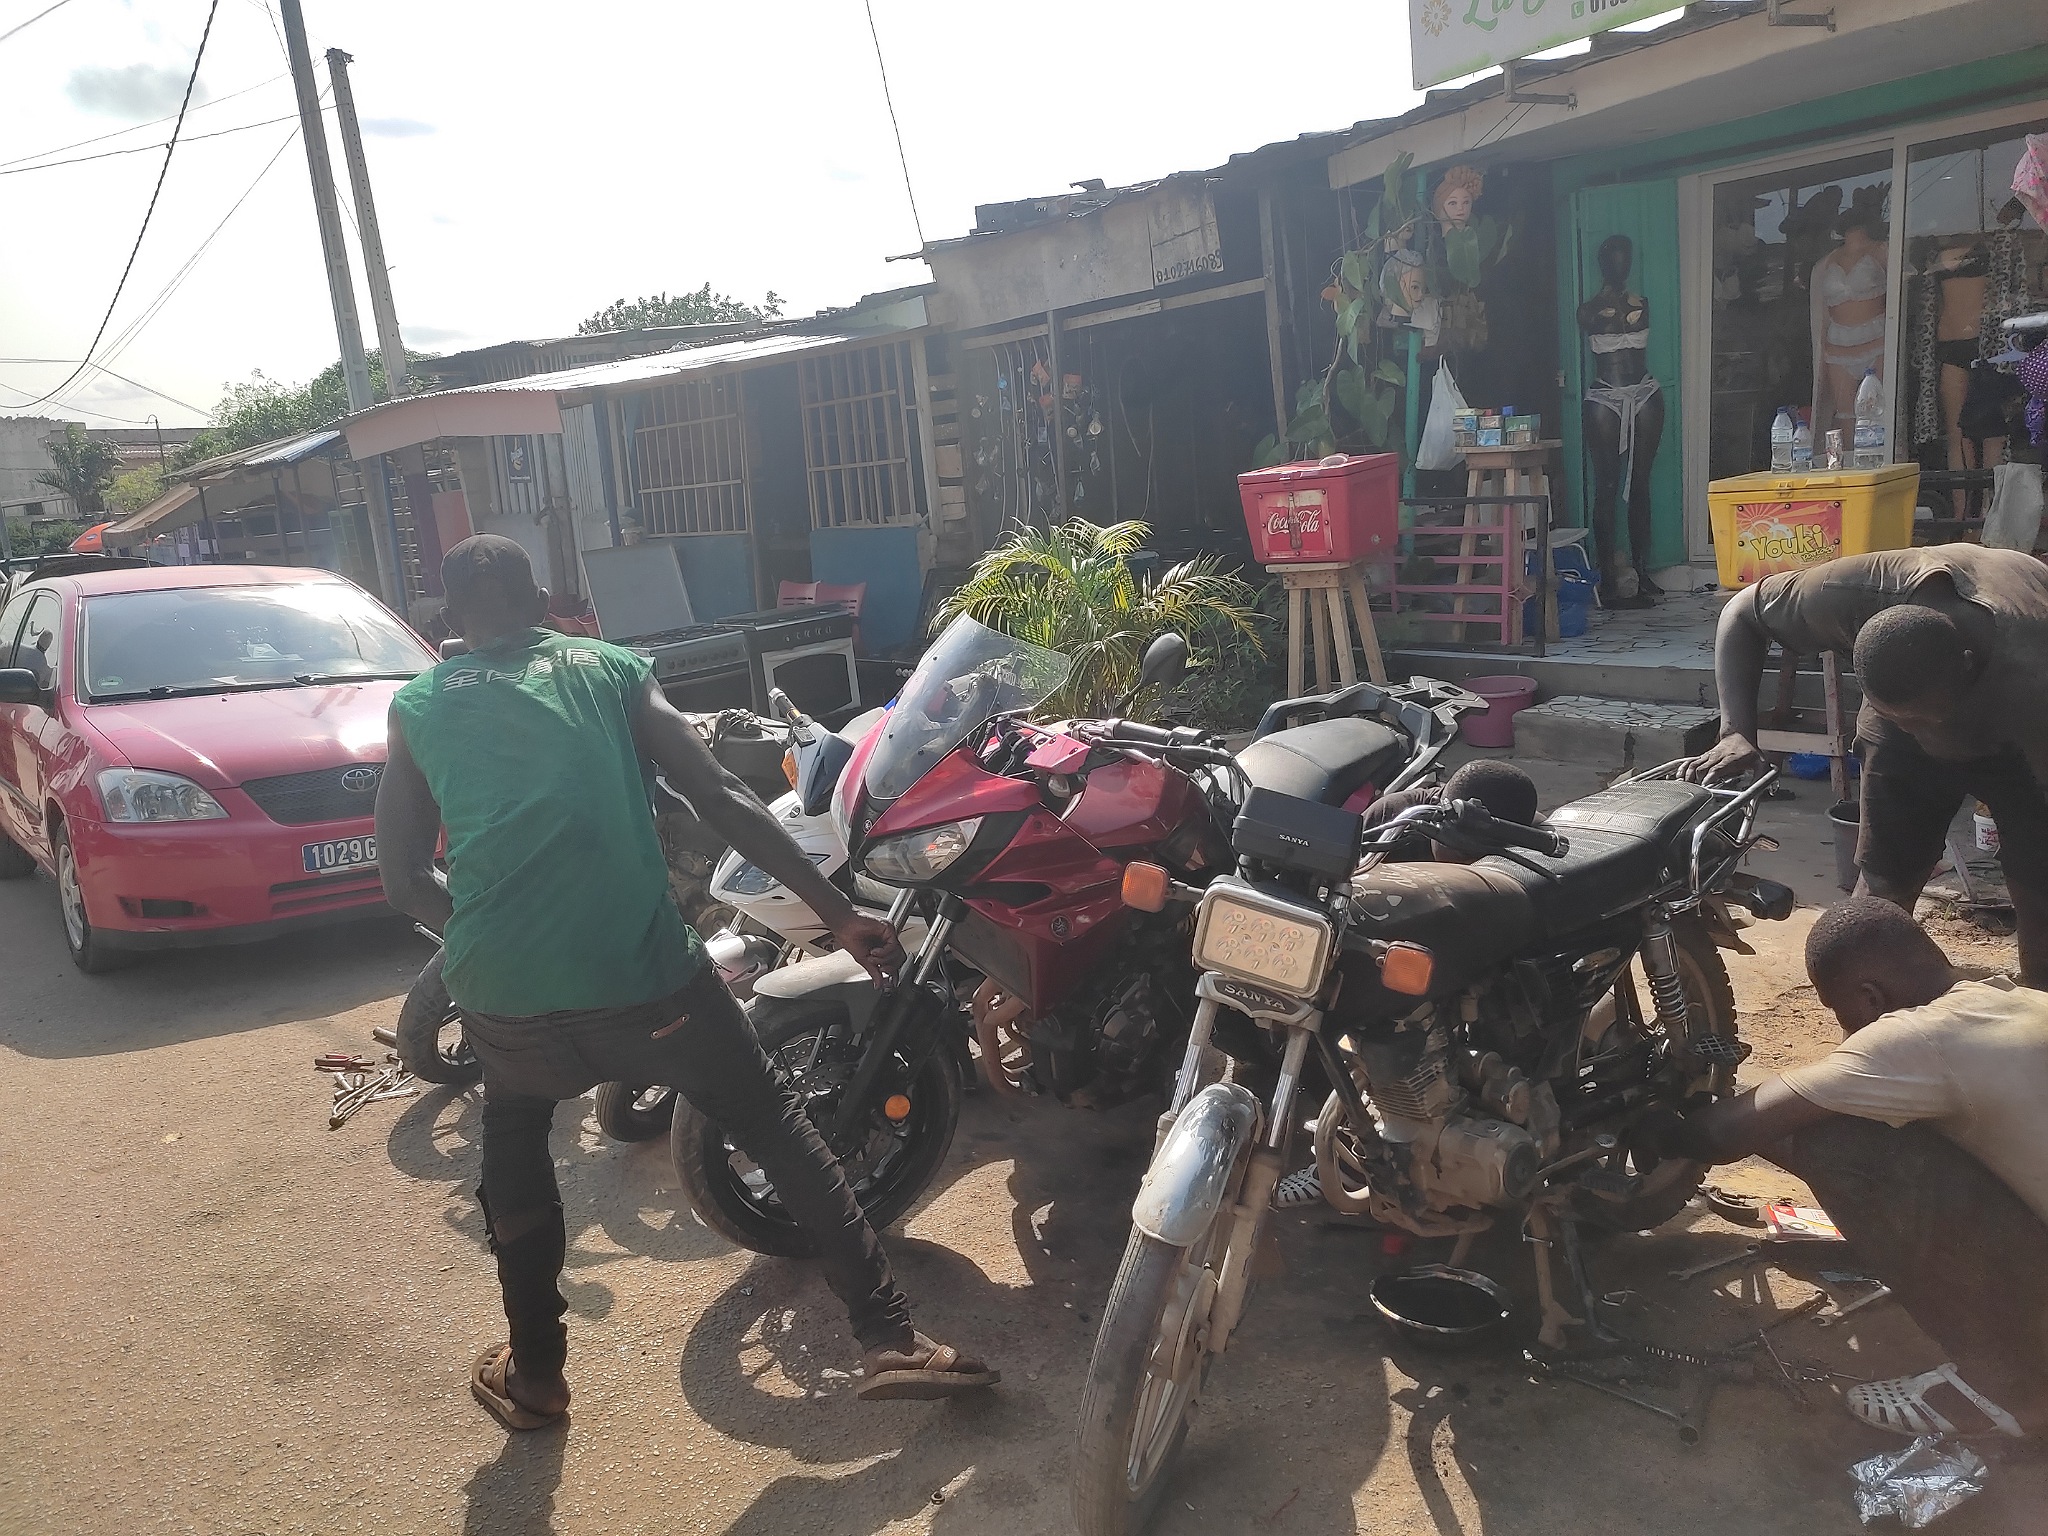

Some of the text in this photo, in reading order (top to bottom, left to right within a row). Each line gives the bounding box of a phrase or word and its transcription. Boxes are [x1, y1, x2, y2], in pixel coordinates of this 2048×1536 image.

[1156, 249, 1223, 283] 0102716089
[1268, 509, 1321, 535] CocaCola
[1750, 523, 1825, 561] Youki
[1279, 833, 1309, 847] SANYA
[1224, 983, 1286, 1010] SANYA
